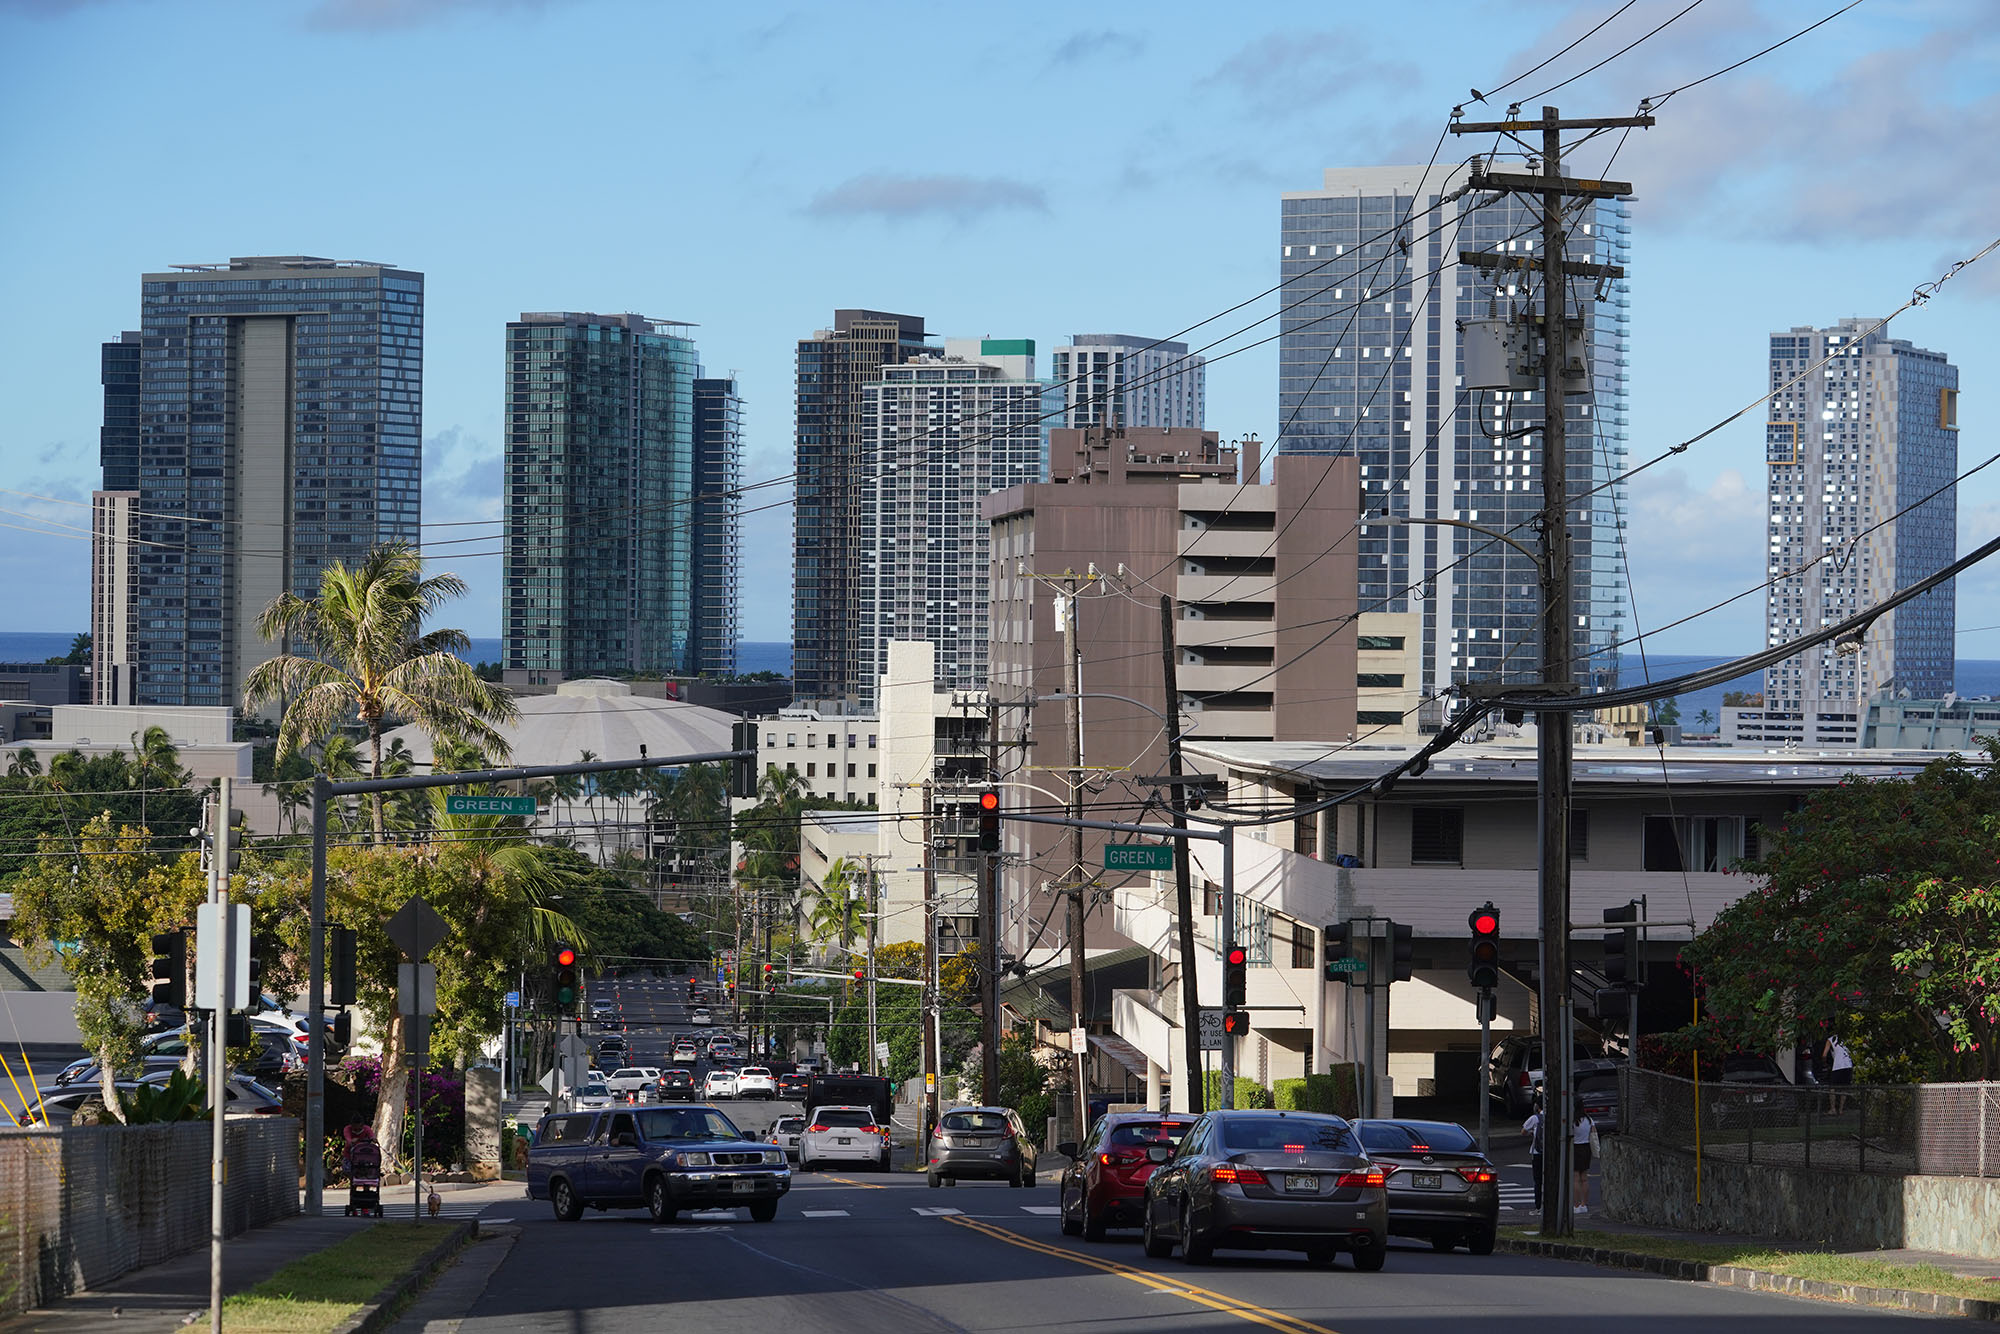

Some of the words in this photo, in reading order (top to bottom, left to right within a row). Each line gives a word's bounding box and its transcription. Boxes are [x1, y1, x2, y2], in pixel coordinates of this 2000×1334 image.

[454, 800, 513, 811] GREEN
[1110, 851, 1155, 864] GREEN
[1160, 857, 1168, 865] ST
[1333, 963, 1357, 971] GREEN
[1286, 1178, 1299, 1187] SNF
[1304, 1179, 1317, 1188] 631
